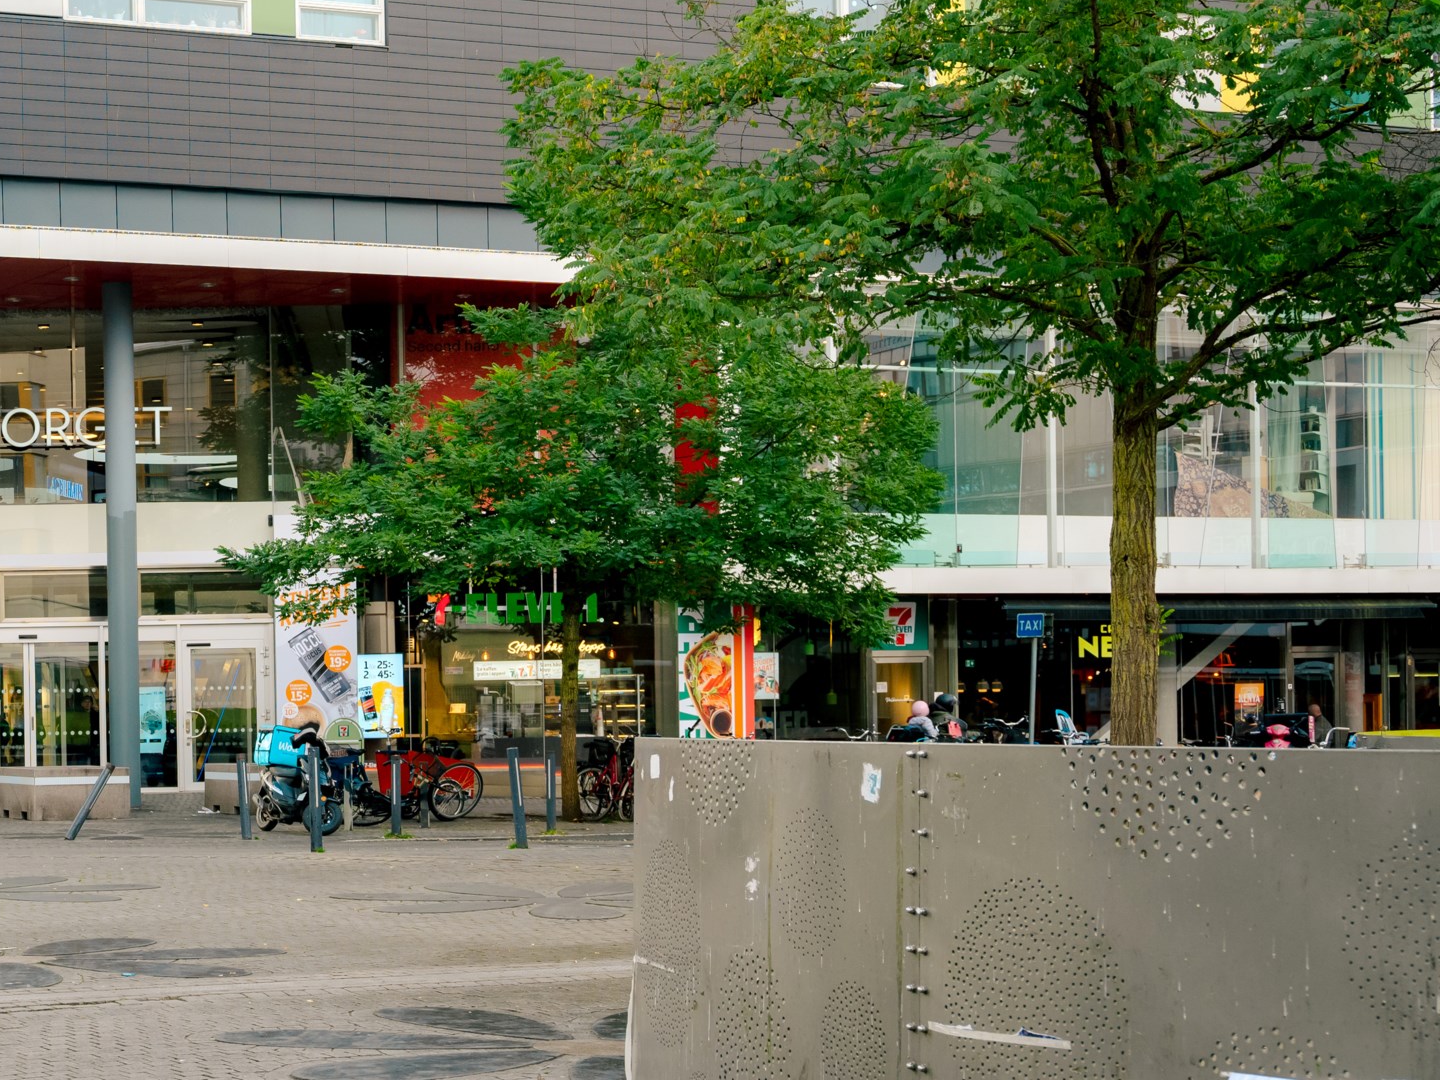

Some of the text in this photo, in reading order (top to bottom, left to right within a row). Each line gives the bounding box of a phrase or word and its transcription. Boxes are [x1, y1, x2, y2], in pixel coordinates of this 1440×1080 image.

[1019, 620, 1042, 631] TAXI
[303, 648, 322, 662] FOCUS
[364, 660, 394, 669] 1 25:-
[363, 670, 395, 679] 2 45:-
[291, 691, 310, 702] 15:-
